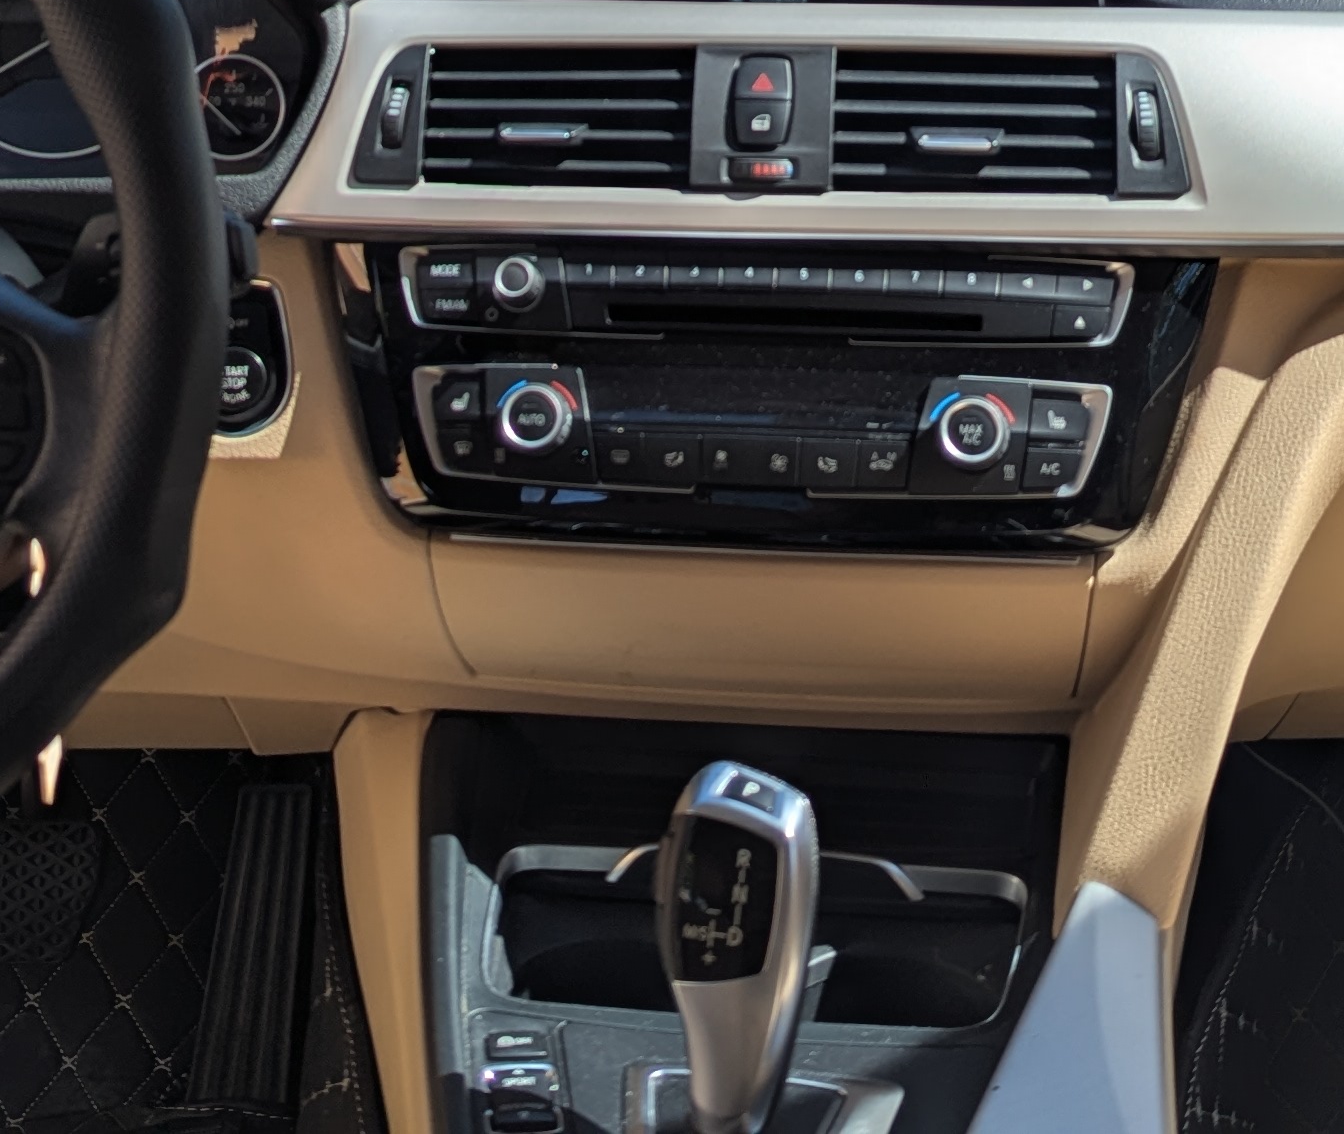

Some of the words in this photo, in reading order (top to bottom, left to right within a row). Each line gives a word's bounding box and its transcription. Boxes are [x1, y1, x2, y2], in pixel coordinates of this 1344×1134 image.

[429, 264, 461, 277] MODE
[585, 263, 593, 276] 1
[635, 264, 645, 277] 2
[799, 267, 809, 280] 5
[854, 269, 865, 282] 6
[911, 270, 920, 283] 7
[967, 272, 977, 285] 8
[222, 365, 250, 376] TART
[517, 413, 546, 427] AUTO
[959, 423, 984, 435] MAX
[962, 434, 982, 446] A/C
[1040, 462, 1061, 476] A/C
[742, 781, 761, 797] P
[736, 848, 752, 867] R
[726, 925, 744, 947] D
